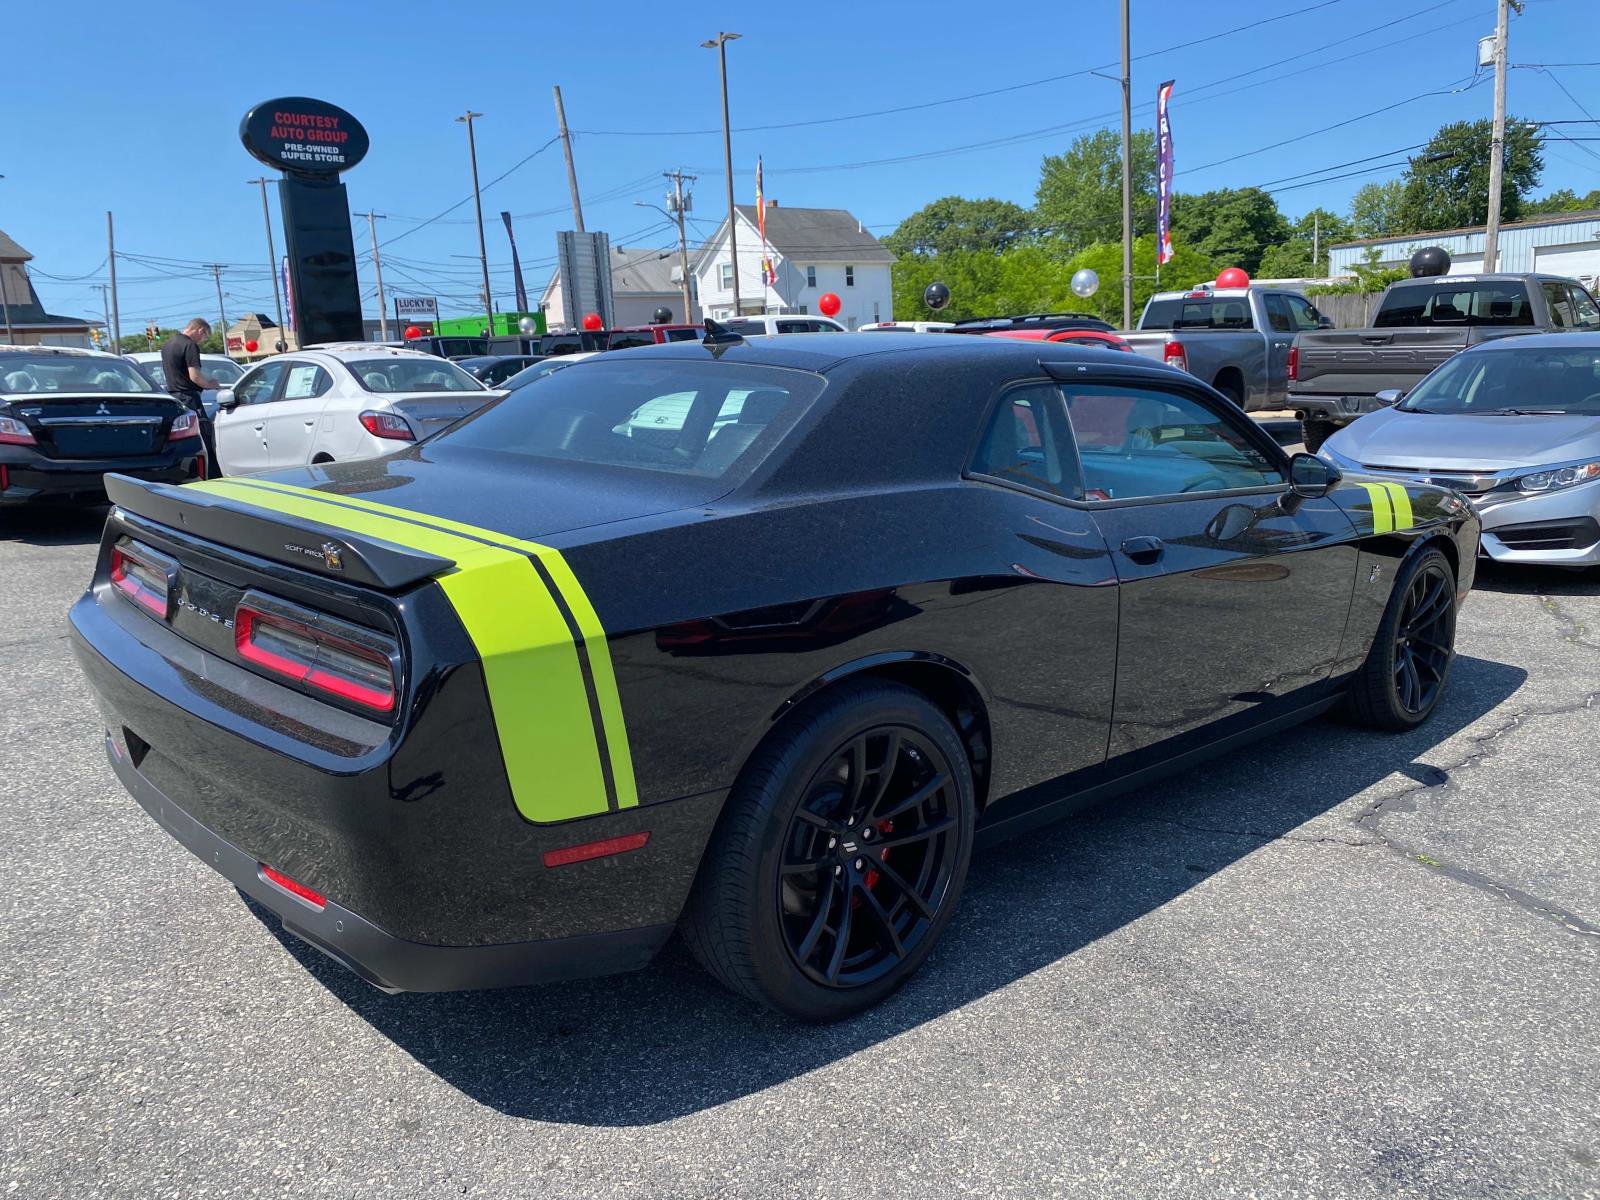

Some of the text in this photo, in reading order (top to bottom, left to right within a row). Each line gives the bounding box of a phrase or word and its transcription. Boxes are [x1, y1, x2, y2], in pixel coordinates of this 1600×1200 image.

[275, 112, 339, 128] COURTESY
[271, 126, 348, 143] AUTO GROUP
[284, 143, 339, 154] PRE-OWNED
[281, 151, 345, 162] SUPER STORE
[399, 299, 425, 307] LUCKY
[177, 598, 234, 629] DODGE
